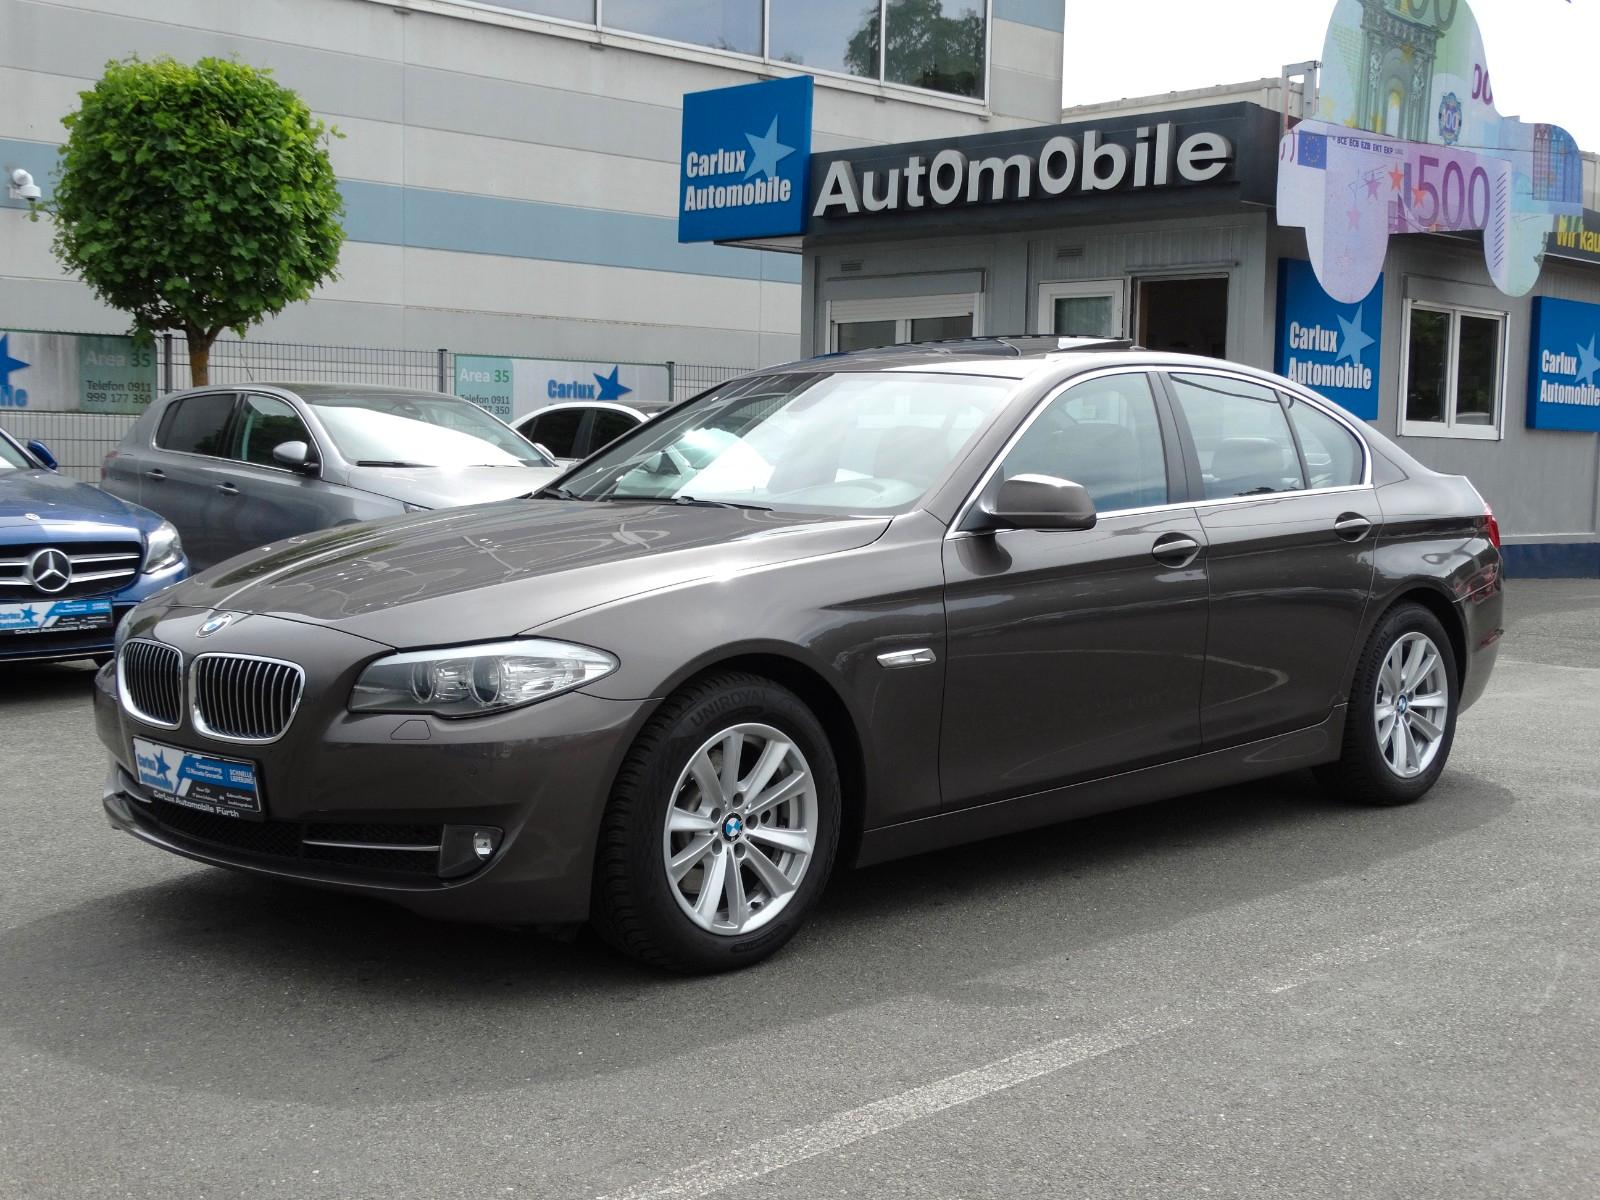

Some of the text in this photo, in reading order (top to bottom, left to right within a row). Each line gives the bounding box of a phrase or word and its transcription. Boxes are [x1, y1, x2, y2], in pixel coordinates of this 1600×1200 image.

[686, 148, 746, 178] Carlux
[684, 176, 792, 212] Automobile
[1417, 154, 1491, 231] 500
[1289, 321, 1338, 353] Carlux
[86, 350, 151, 368] Area 35
[1542, 349, 1577, 376] Carlux
[459, 367, 510, 383] Area 35
[1288, 357, 1373, 390] Automobile
[86, 379, 152, 393] Telefon 0911
[547, 379, 596, 400] Carlux
[1540, 379, 1600, 407] Automobile
[86, 392, 152, 404] 999 177 350
[491, 394, 510, 405] 0911
[495, 404, 510, 415] 350
[176, 797, 215, 813] Automobile
[216, 805, 240, 818] Fürth
